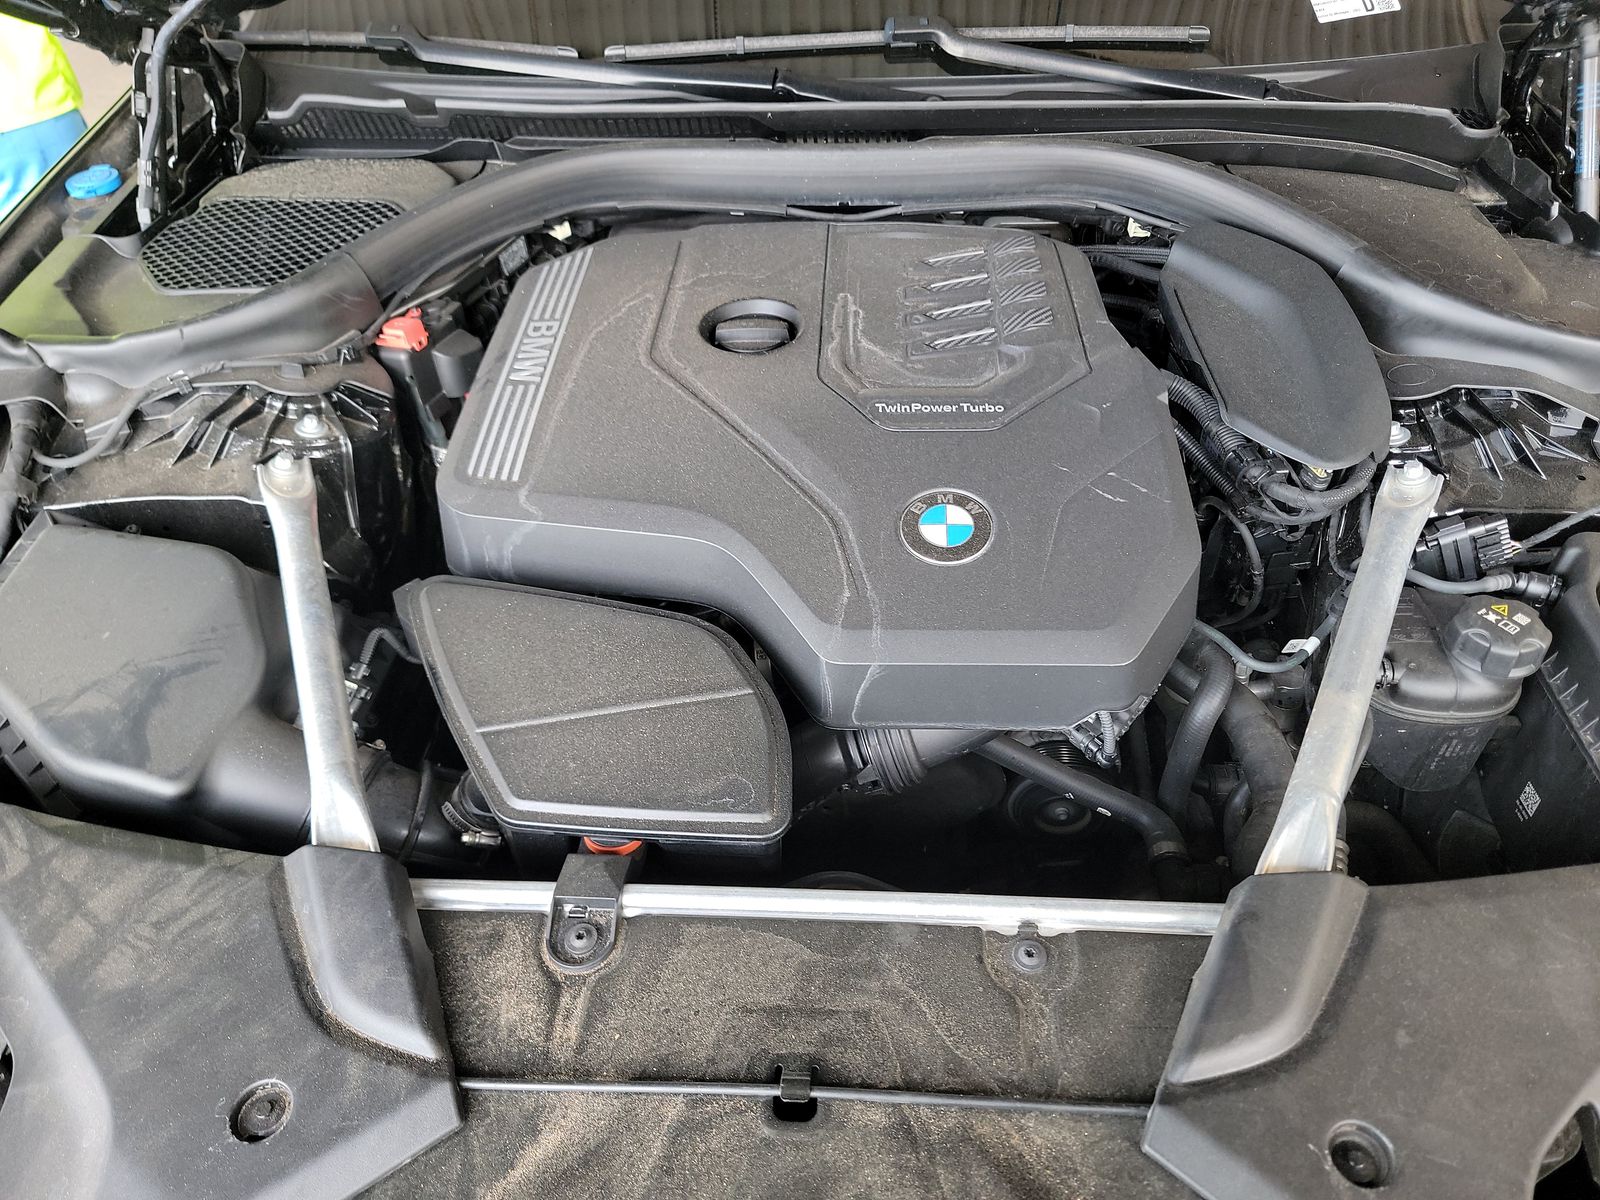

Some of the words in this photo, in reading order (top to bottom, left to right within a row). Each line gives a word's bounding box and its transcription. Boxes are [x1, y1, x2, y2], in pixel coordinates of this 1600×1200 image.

[508, 320, 560, 381] BMW
[874, 402, 959, 413] TwinPower
[959, 402, 1005, 413] Turbo
[909, 494, 983, 515] BMW
